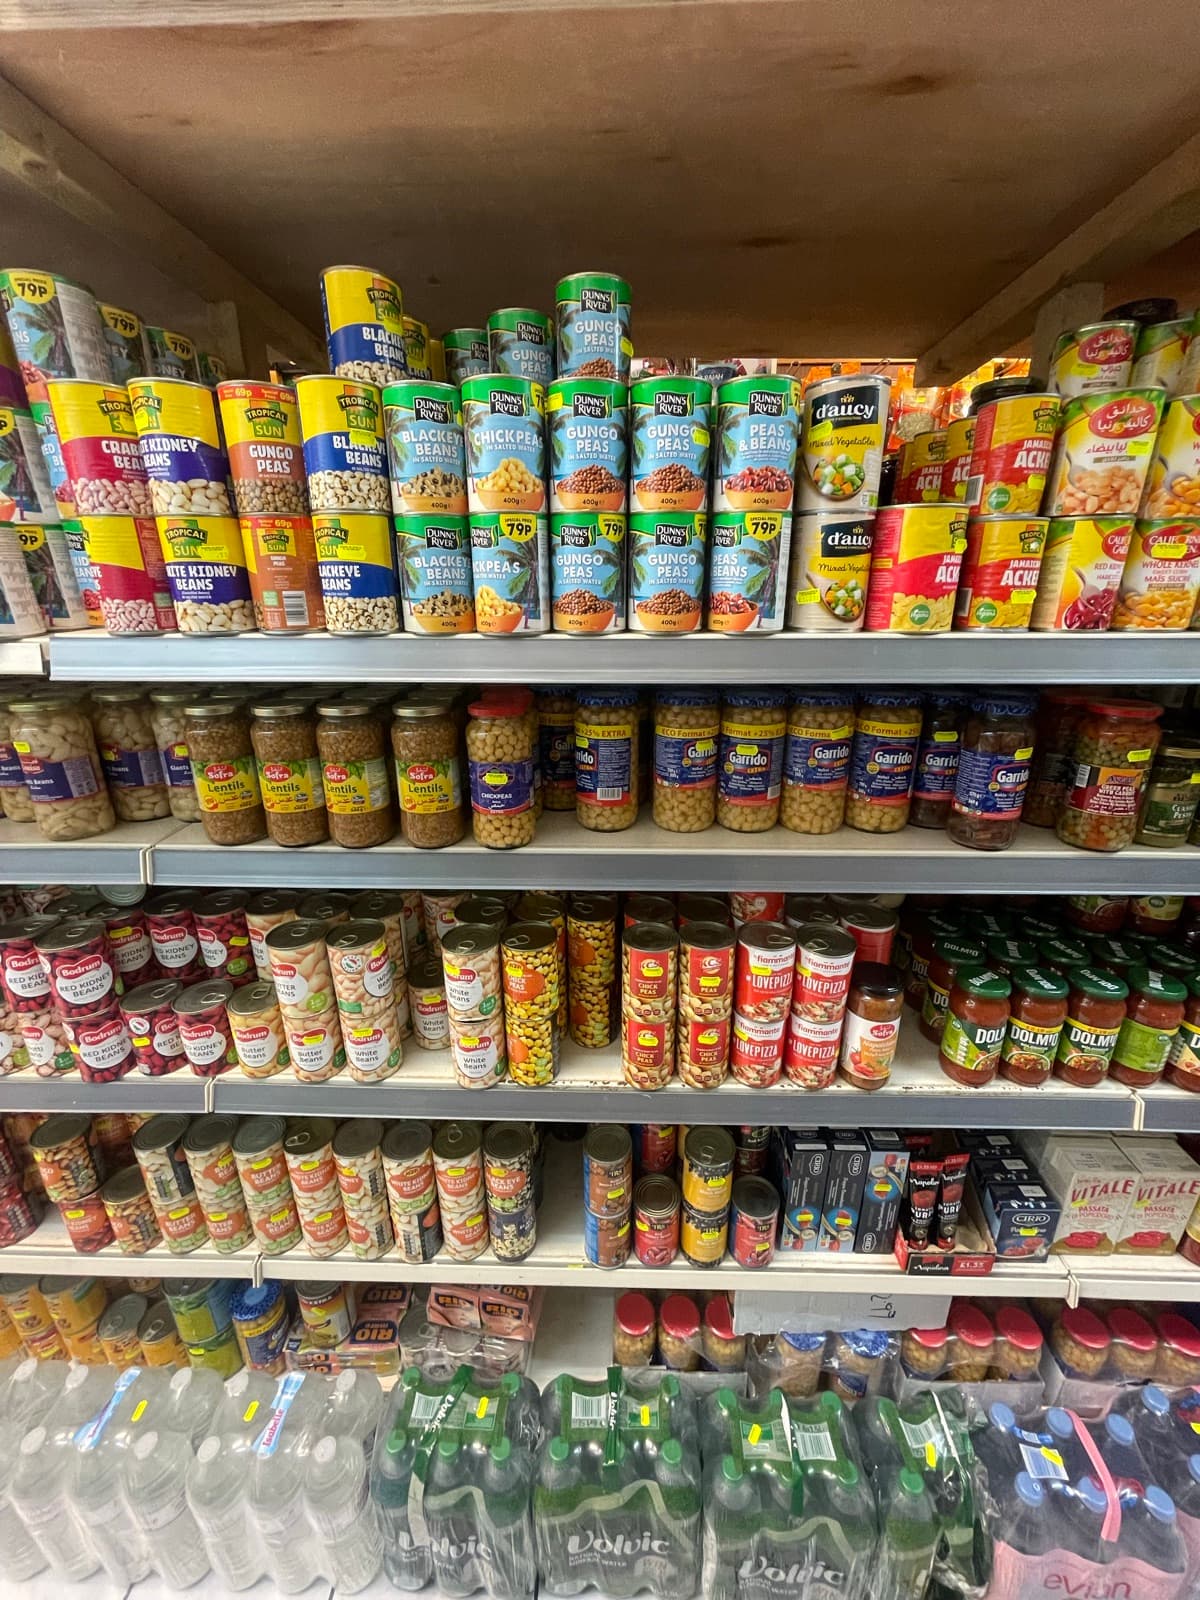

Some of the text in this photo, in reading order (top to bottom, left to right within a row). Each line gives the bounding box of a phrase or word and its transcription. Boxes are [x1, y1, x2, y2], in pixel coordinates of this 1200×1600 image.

[18, 284, 47, 296] 79P
[582, 291, 610, 301] DUNN'S
[585, 300, 607, 311] RIVER
[110, 316, 135, 332] 79P
[575, 322, 622, 334] GUNGO
[522, 332, 540, 342] RIVER
[584, 334, 614, 346] PEAS
[512, 350, 551, 362] GUNGO
[521, 362, 547, 373] PEAS
[235, 388, 252, 398] 69p
[491, 393, 521, 404] DUNN'S
[656, 393, 686, 404] DUNN'S
[751, 393, 781, 404] DUNN'S
[340, 398, 378, 410] TROPICAL
[415, 399, 447, 412] DUNN'S
[574, 395, 604, 407] DUNN'S
[420, 407, 444, 421] RIVER
[496, 402, 519, 414] RIVER
[578, 404, 601, 416] RIVER
[661, 402, 683, 414] RIVER
[755, 402, 777, 414] RIVER
[816, 402, 874, 419] d'aucy
[246, 409, 287, 422] TROPICAL
[349, 414, 375, 428] SUN
[255, 425, 281, 436] SUN
[567, 425, 618, 440] GUNGO
[750, 424, 784, 437] PEAS
[150, 439, 198, 452] KIDNEY
[416, 444, 458, 456] BEANS
[576, 440, 609, 452] PEAS
[657, 439, 690, 451] PEAS
[739, 438, 791, 452] & BEANS
[249, 445, 293, 460] GUNGO
[144, 454, 170, 467] BEANS
[345, 451, 383, 468] BEANS
[257, 462, 290, 473] PEAS
[583, 498, 598, 506] 400g
[661, 497, 677, 505] 400g
[753, 497, 769, 505] 400g
[275, 519, 292, 529] 69p
[507, 523, 531, 536] 79P
[605, 524, 622, 536] 79P
[656, 524, 686, 535] DUNN'S
[752, 523, 776, 534] 79P
[166, 528, 205, 540] TROPICAL
[427, 529, 456, 539] DUNN'S
[561, 526, 588, 537] DUNN'S
[432, 537, 454, 547] RIVER
[565, 535, 584, 545] RIVER
[660, 534, 682, 544] RIVER
[174, 545, 200, 556] SUN
[268, 544, 285, 552] SUN
[557, 554, 603, 565] GUNGO
[648, 554, 696, 566] GUNGO
[1143, 561, 1170, 569] WHOLE
[189, 566, 237, 577] KIDNEY
[563, 566, 593, 577] PEAS
[657, 566, 688, 578] PEAS
[713, 566, 747, 578] BEANS
[819, 563, 843, 571] Mixed
[427, 568, 465, 580] BEANS
[176, 578, 213, 590] BEANS
[725, 726, 751, 736] Format
[871, 726, 899, 734] Format
[814, 746, 850, 759] Garrido
[875, 751, 913, 765] Garrido
[729, 752, 767, 766] Garrido
[207, 771, 234, 779] Sofra
[266, 771, 290, 780] Sofra
[325, 771, 347, 780] Sofra
[410, 771, 434, 780] Sofra
[997, 769, 1030, 785] Garrido
[208, 781, 245, 793] Lentils
[266, 781, 300, 793] Lentils
[326, 782, 357, 793] Lentils
[408, 782, 443, 793] Lentils
[165, 943, 194, 954] KIDNEY
[160, 952, 188, 961] BEANS
[61, 960, 100, 977] Bodrum
[60, 972, 110, 993] RED KIDNEY
[752, 974, 793, 988] LOVEPIZZA
[802, 978, 845, 992] LOVEPIZZA
[73, 983, 105, 997] BEANS
[85, 1024, 120, 1043] Bodrum
[1011, 1026, 1057, 1046] DOLMIO
[193, 1040, 223, 1051] KIDNEY
[736, 1040, 777, 1057] LOVEPIZZA
[793, 1040, 835, 1057] LOVEPIZZA
[96, 1046, 125, 1061] BEANS
[298, 1050, 322, 1058] Butter
[1071, 1180, 1135, 1201] VITALE
[1137, 1180, 1199, 1201] VITALE
[1016, 1214, 1047, 1223] CIRIO
[355, 1329, 394, 1340] RIO
[262, 1408, 284, 1446] Isabelle
[568, 1531, 670, 1556] Volvic
[738, 1556, 844, 1584] Volvic
